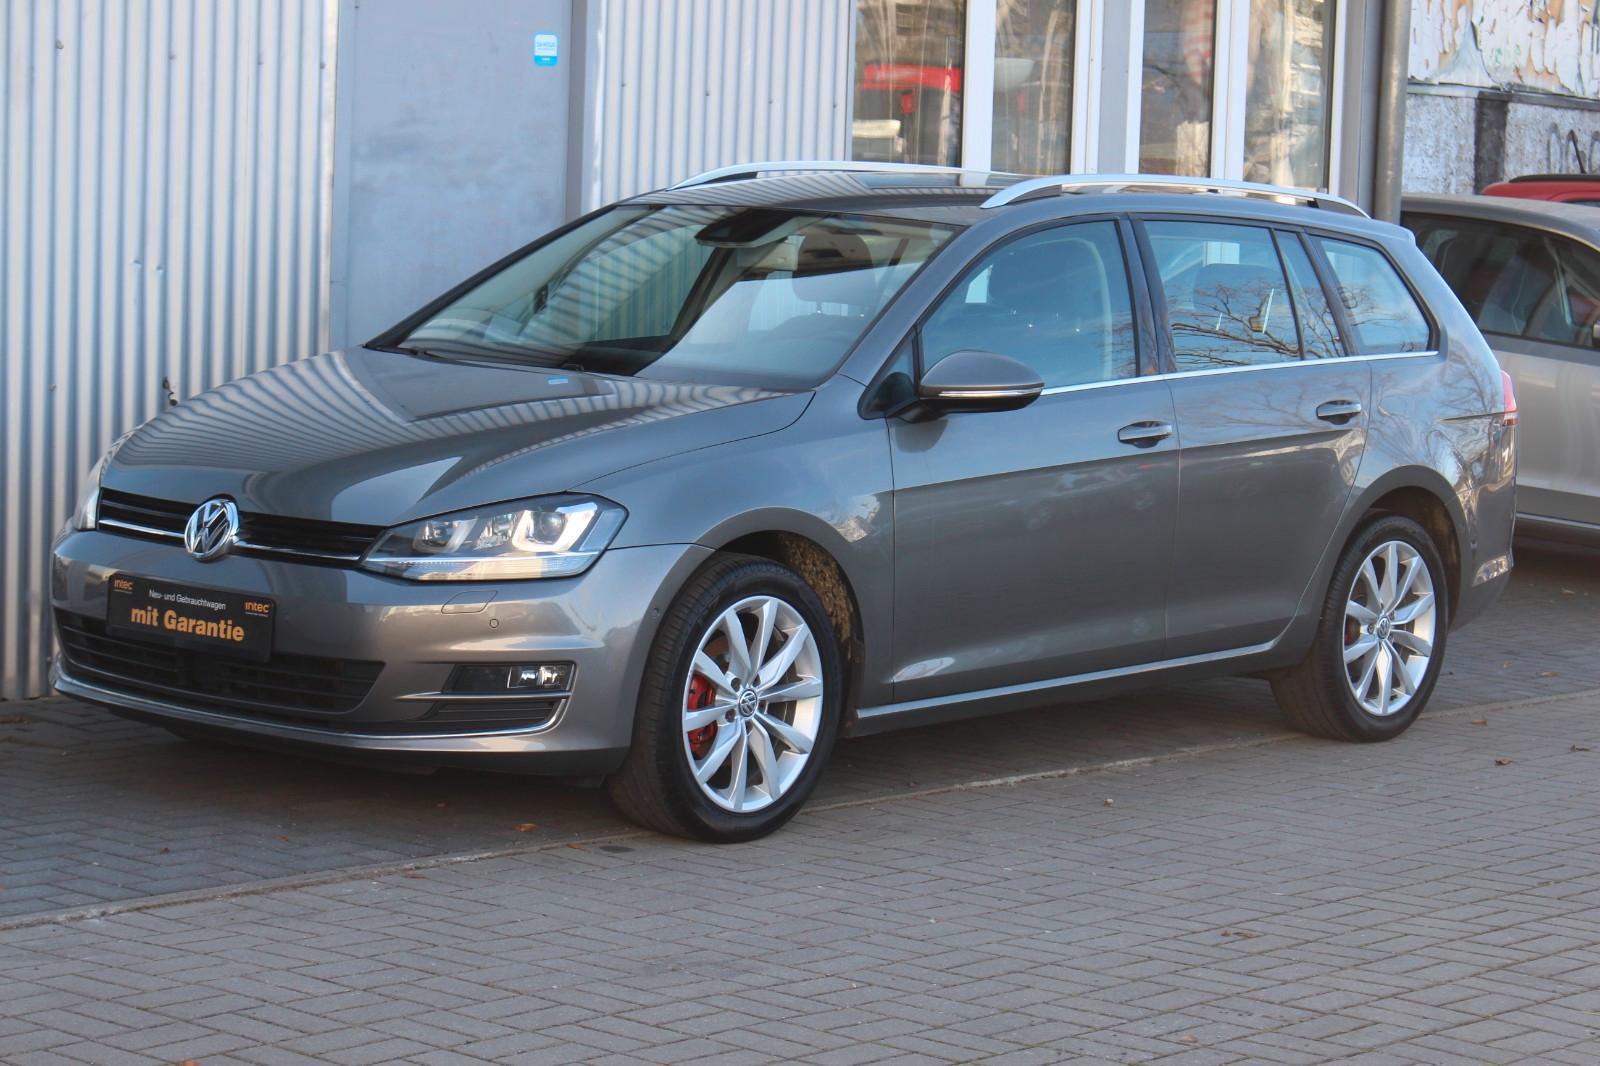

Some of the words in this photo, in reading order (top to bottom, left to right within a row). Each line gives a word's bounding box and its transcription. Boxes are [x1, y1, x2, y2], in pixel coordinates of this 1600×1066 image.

[163, 593, 176, 602] und
[176, 594, 227, 612] Gebrauchtwagen
[245, 601, 270, 613] intec
[131, 605, 159, 627] mit
[163, 609, 245, 642] Garantie
